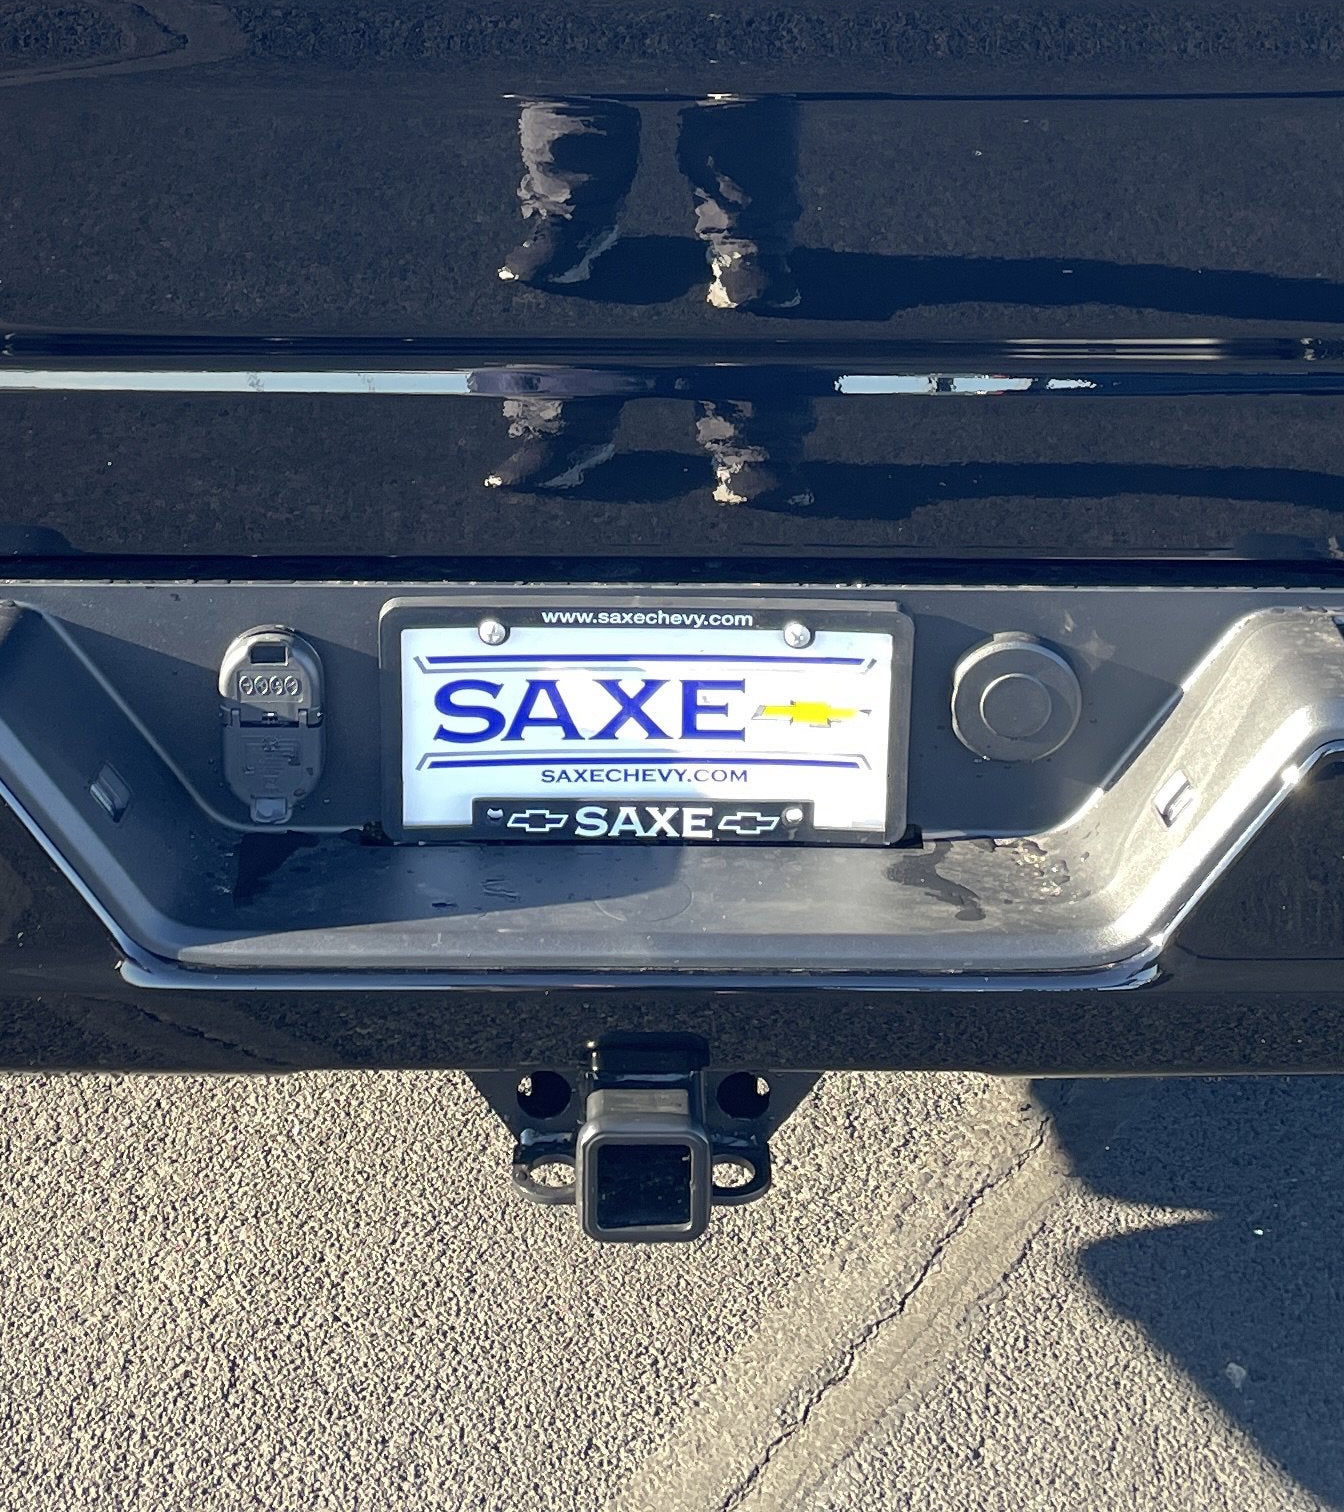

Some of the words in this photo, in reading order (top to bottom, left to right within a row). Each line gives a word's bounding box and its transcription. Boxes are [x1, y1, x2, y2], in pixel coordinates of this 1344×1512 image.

[541, 609, 753, 628] www.saxechevy.com
[433, 678, 746, 743] SAXE
[540, 768, 749, 784] SAXECHEVY.COM
[574, 805, 713, 839] SAXE
